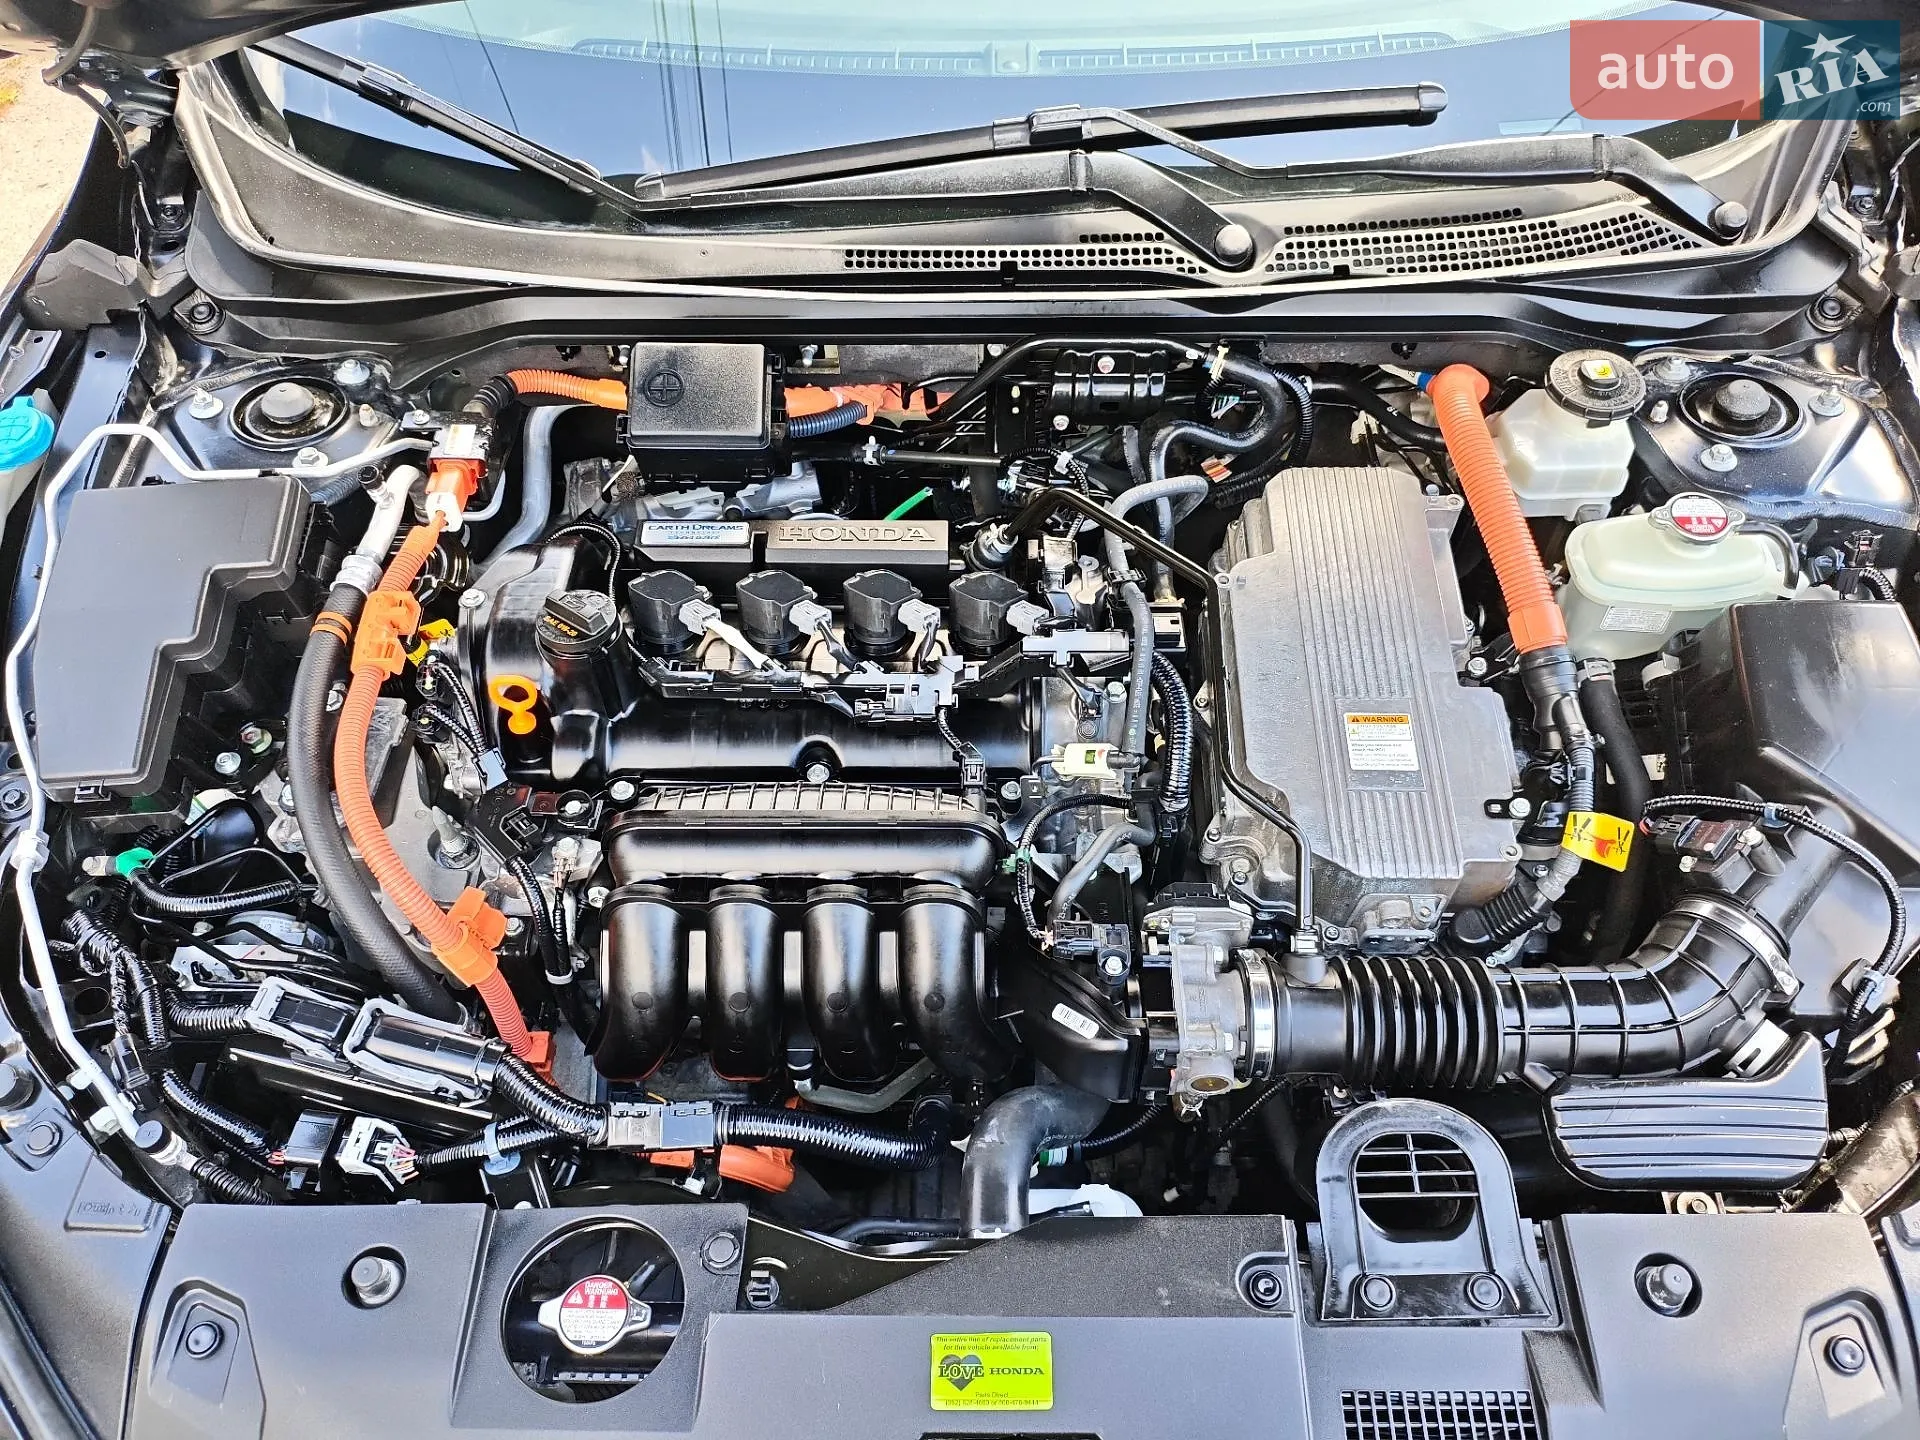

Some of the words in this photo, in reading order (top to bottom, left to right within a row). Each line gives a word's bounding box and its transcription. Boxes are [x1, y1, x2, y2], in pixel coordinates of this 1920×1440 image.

[779, 526, 936, 542] HONDA
[938, 1365, 985, 1380] LOVE
[989, 1367, 1045, 1375] HONDA
